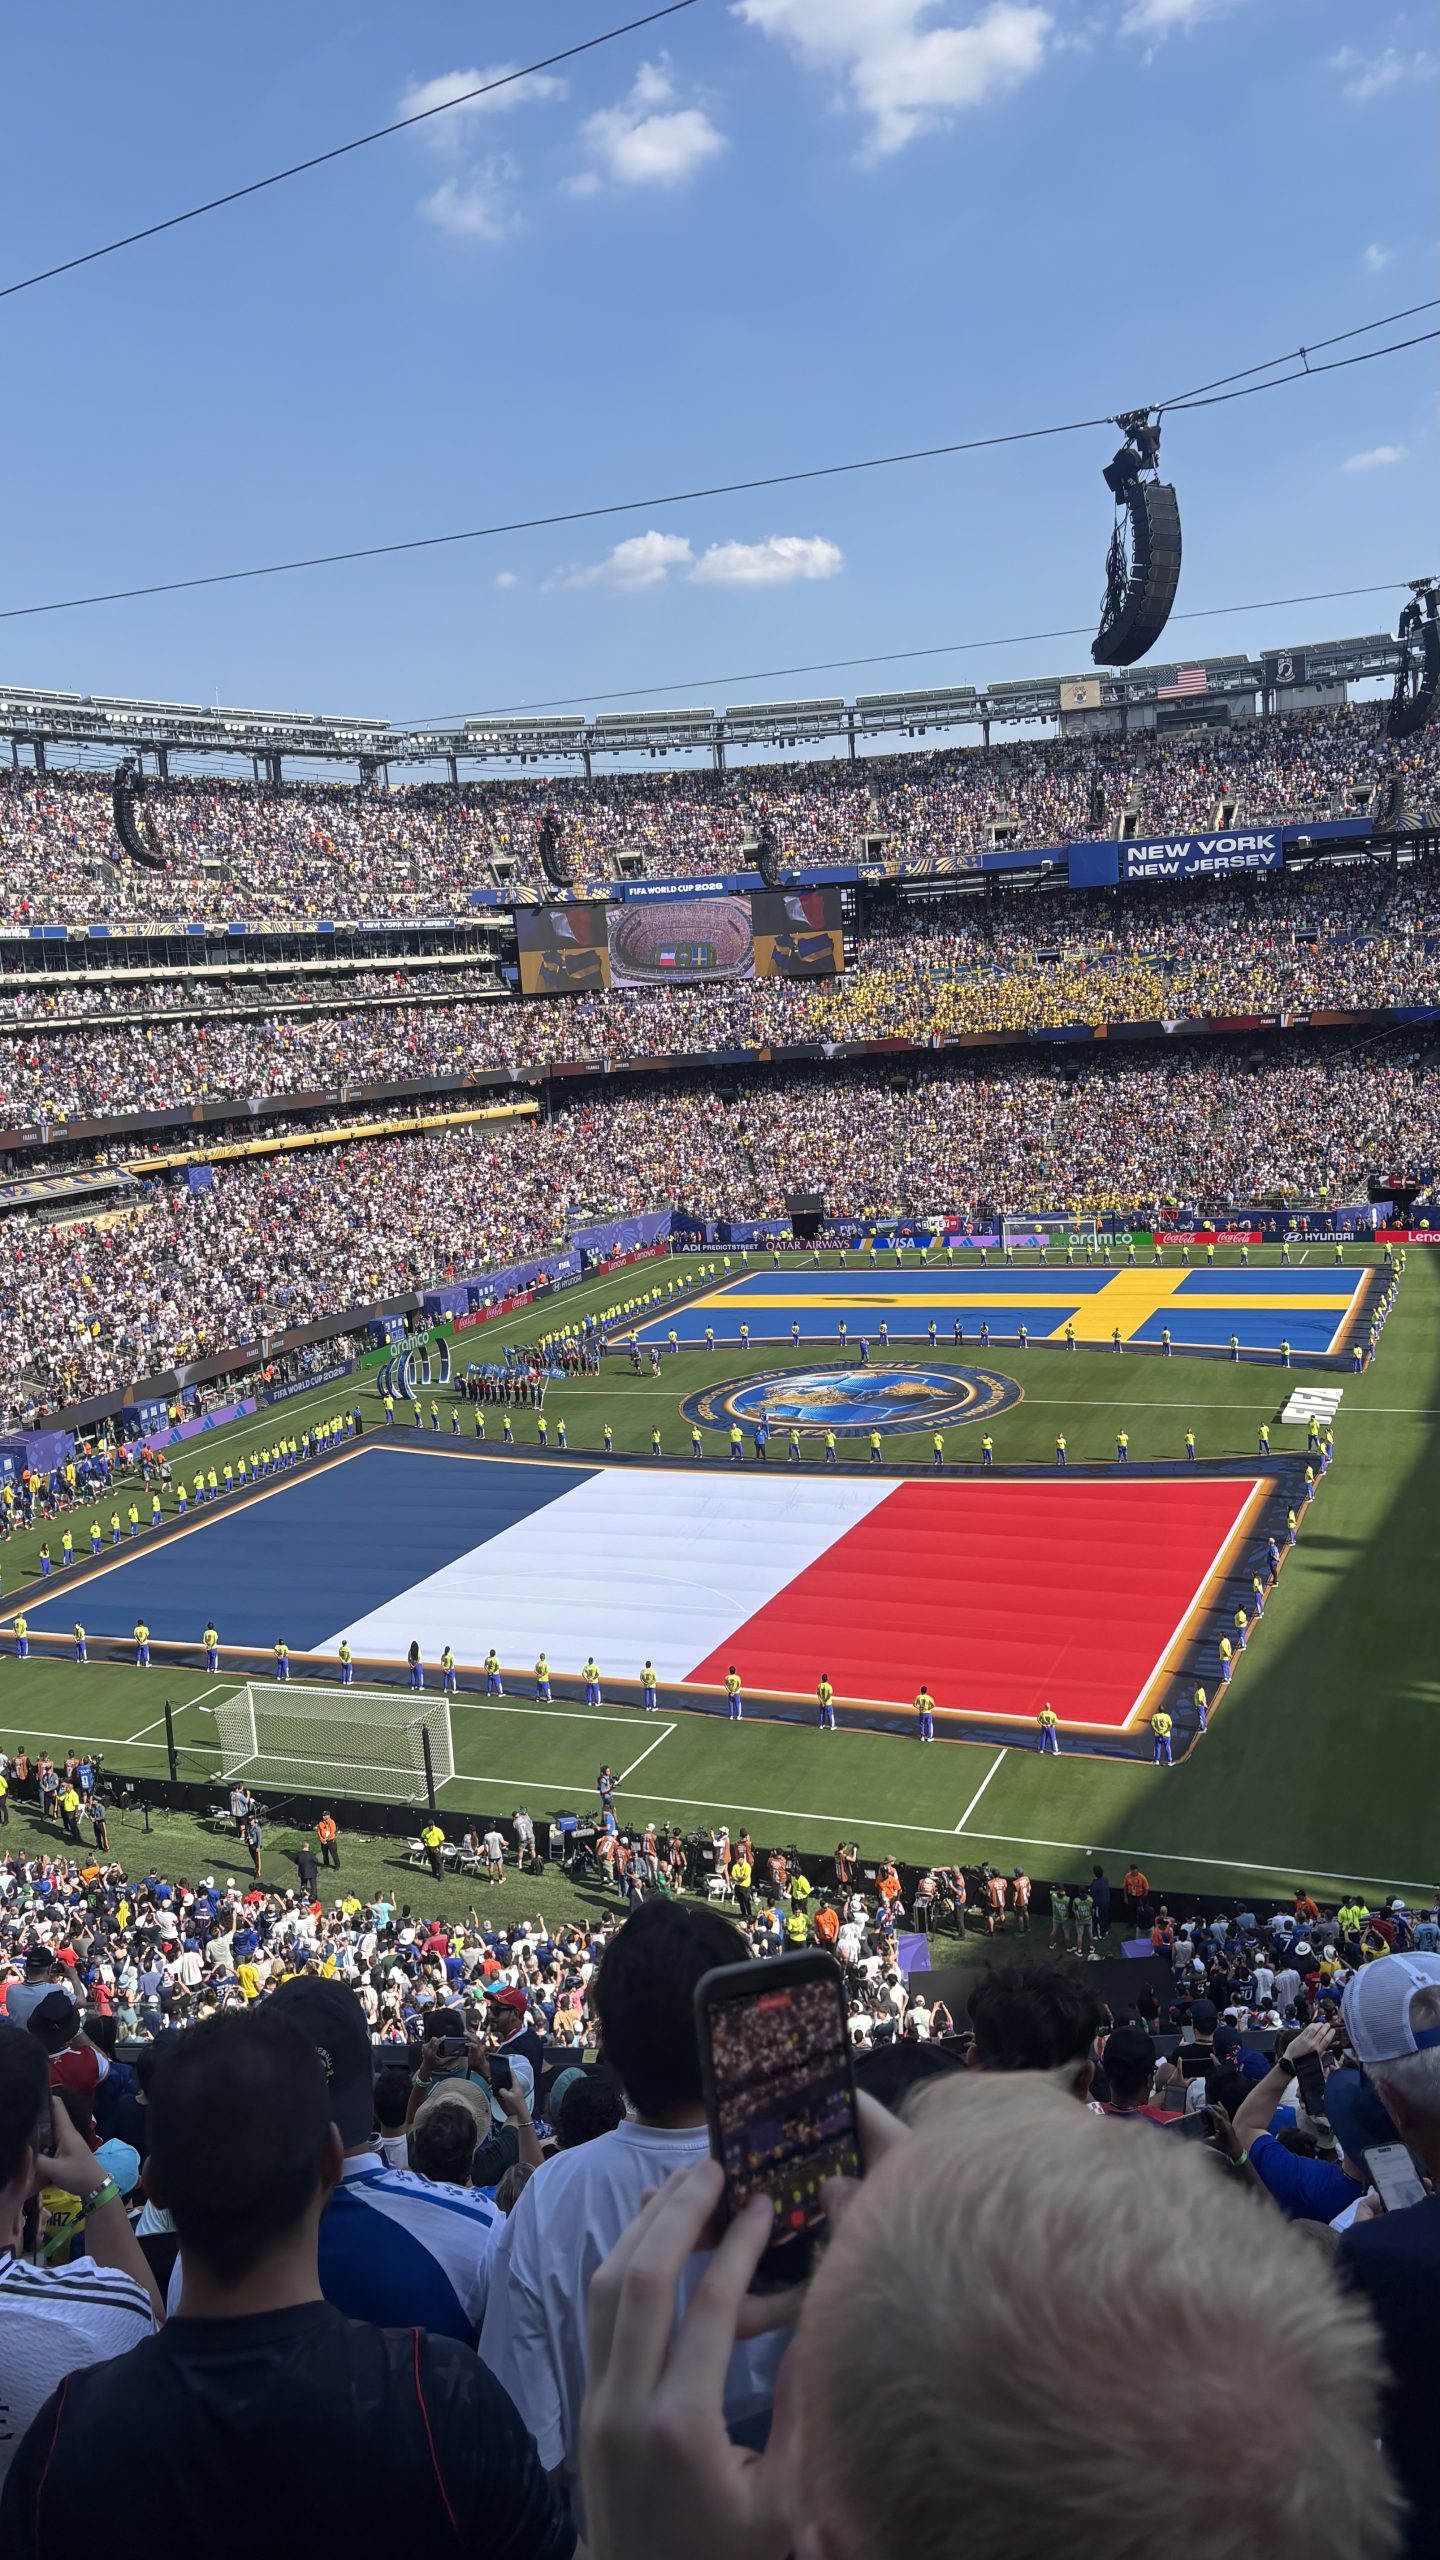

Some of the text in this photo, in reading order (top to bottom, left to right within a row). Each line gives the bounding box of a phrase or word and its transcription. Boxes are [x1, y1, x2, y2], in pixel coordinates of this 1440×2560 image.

[1127, 834, 1276, 862] NEW YORK
[1128, 853, 1276, 877] NEW JERSEY
[629, 882, 723, 896] FIFA WORLD CUP 2026
[766, 1239, 850, 1251] QATAR AIRWAYS
[886, 1238, 915, 1248] VISA
[1069, 1233, 1133, 1244] aramco
[634, 1248, 656, 1261] Lenovo
[558, 1260, 570, 1270] FIFA
[608, 1258, 626, 1271] Lenovo
[561, 1273, 582, 1289] HYUNDAI
[390, 1332, 429, 1356] aramco
[274, 1390, 287, 1400] FIFA
[288, 1380, 310, 1395] WORLD
[310, 1375, 323, 1386] CUP
[1283, 1938, 1291, 1952] 7
[1240, 1990, 1253, 2001] 10
